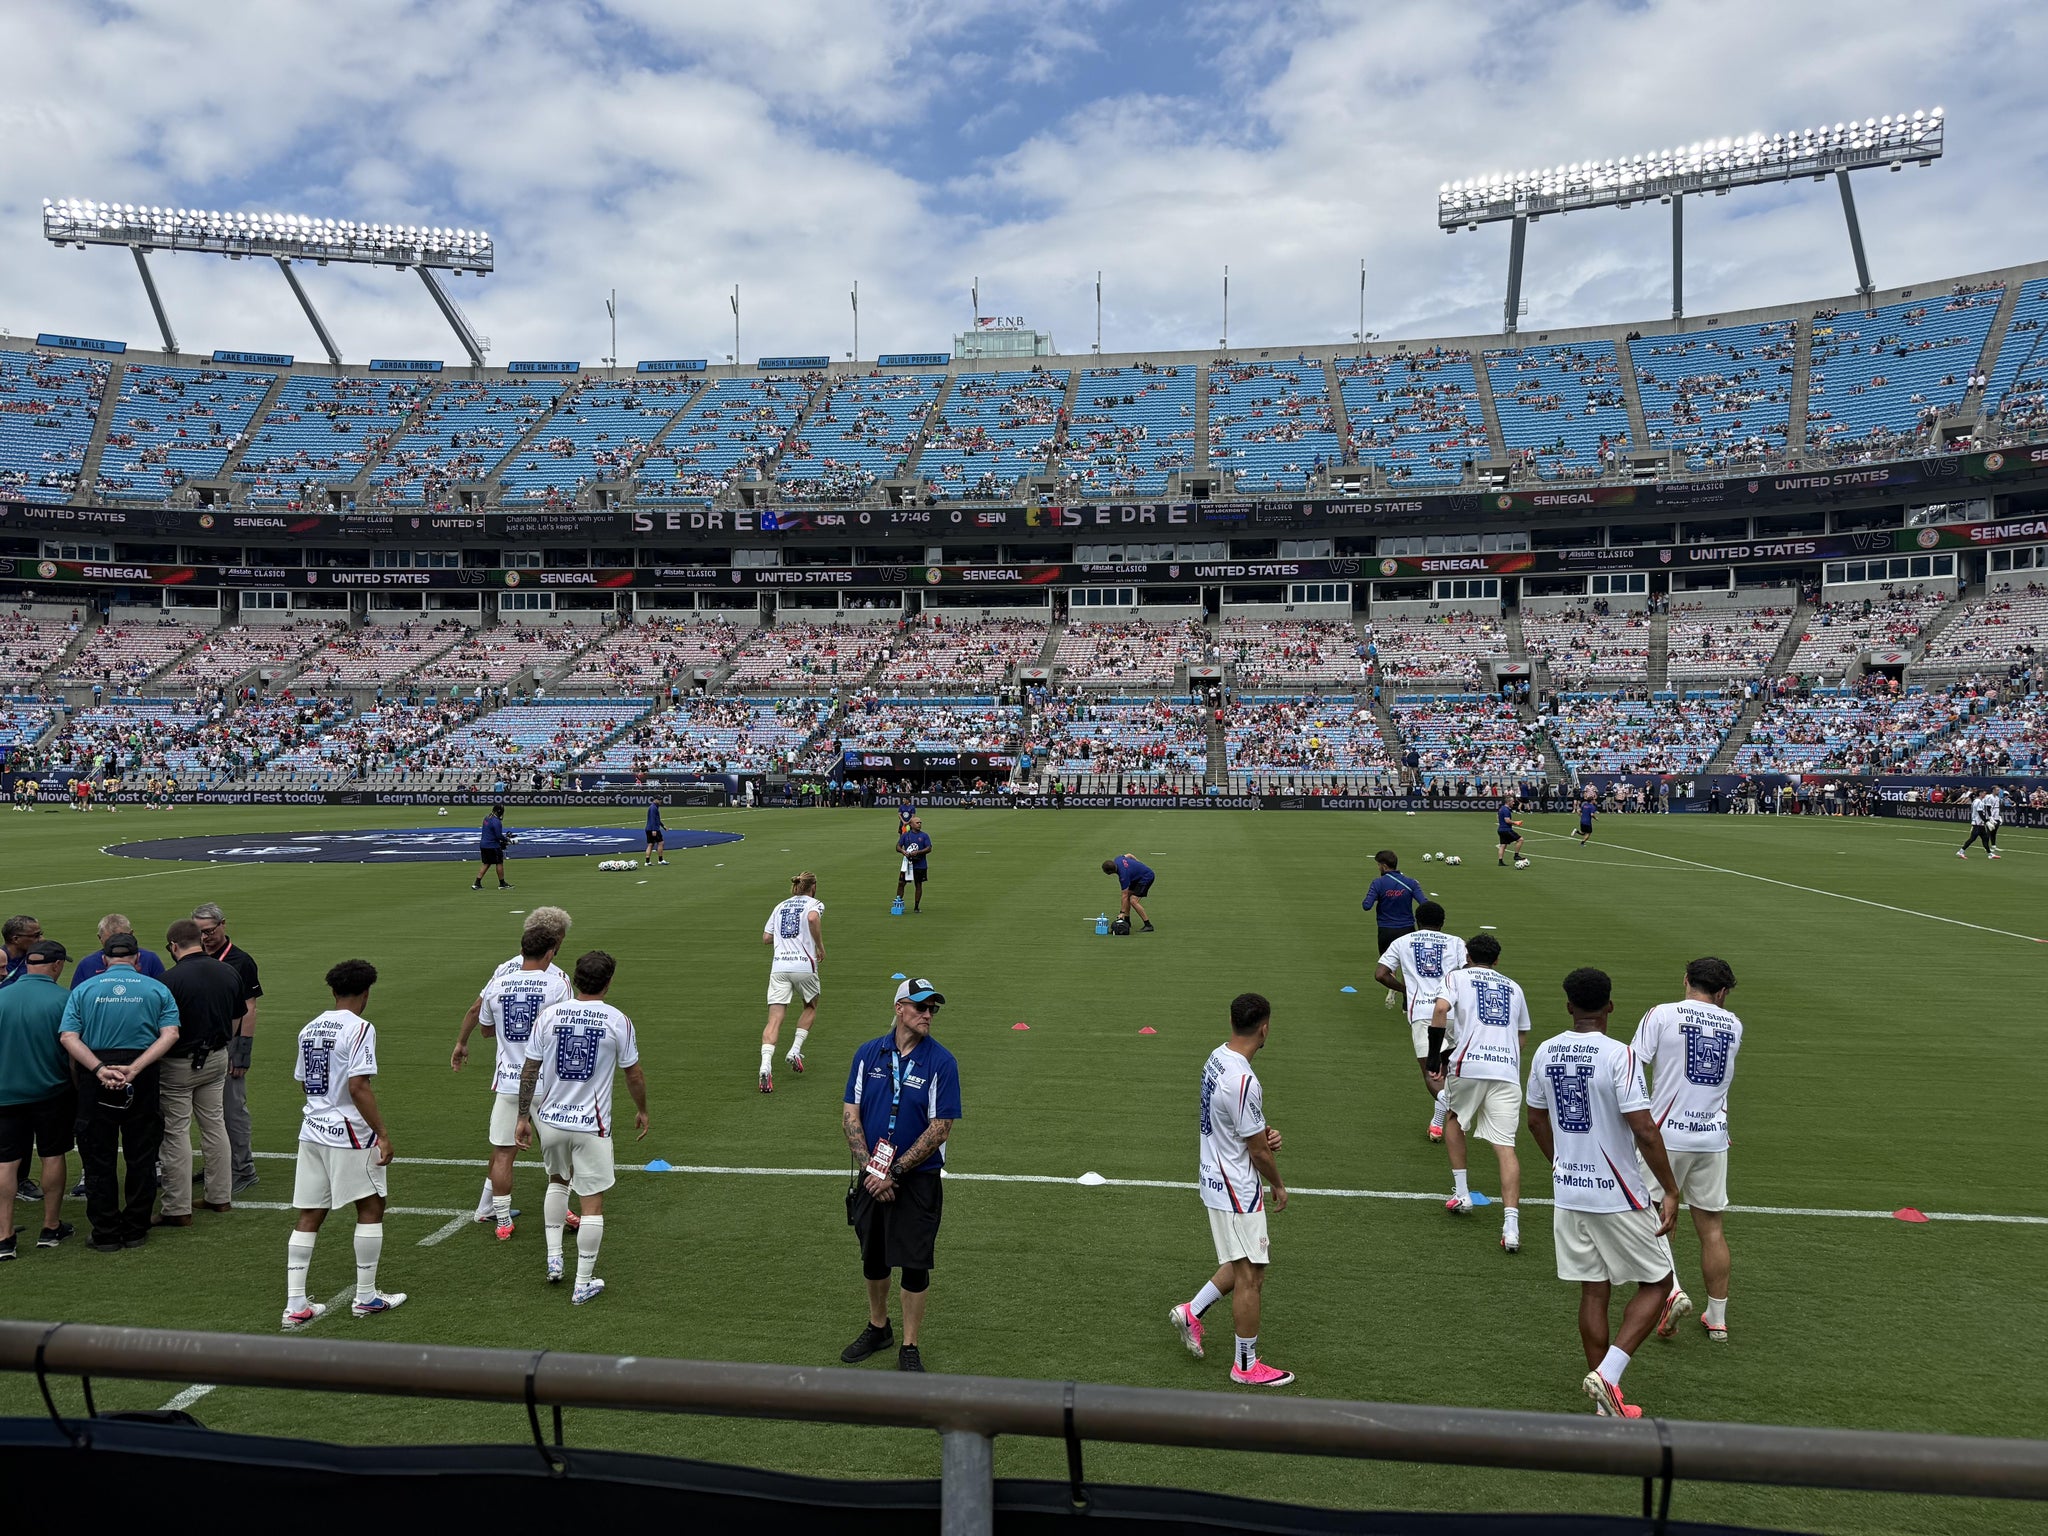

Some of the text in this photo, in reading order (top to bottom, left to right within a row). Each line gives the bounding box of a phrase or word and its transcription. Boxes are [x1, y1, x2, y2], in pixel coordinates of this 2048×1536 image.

[59, 337, 106, 350] SAM MILLS
[222, 353, 286, 364] JAKE DELHOMME
[761, 358, 826, 367] MUHSIN MUHAMMAD
[885, 355, 942, 365] JULIUS PEPPERS
[379, 360, 433, 370] JORDAN GROSS
[515, 363, 535, 371] STEVE
[537, 363, 559, 371] SMITH
[647, 361, 697, 370] WESLEY WALLS
[1775, 476, 1830, 490] UNITED
[1833, 469, 1889, 486] STATES
[1533, 493, 1594, 505] SENEGAL
[1325, 503, 1371, 514] UNITED
[1374, 502, 1423, 512] STATES
[24, 507, 76, 520] UNITED
[78, 511, 126, 522] STATES
[817, 514, 846, 526] USA
[890, 512, 931, 523] 17:46
[978, 512, 1006, 523] SEN
[233, 517, 287, 528] SENEGAL
[431, 519, 472, 528] UNITED
[506, 524, 519, 532] just
[538, 523, 554, 531] Let's
[555, 523, 573, 532] keep
[1568, 551, 1595, 559] Allstate
[1690, 546, 1750, 560] UNITED
[1753, 542, 1816, 557] STATES
[1194, 559, 1360, 577] UNITED STATES VS
[1421, 558, 1489, 572] SENEGAL
[83, 566, 152, 579] SENEGAL
[332, 570, 486, 584] UNITED STATES VS
[540, 573, 597, 584] SENEGAL
[755, 571, 852, 582] UNITED STATES
[878, 567, 908, 582] VS
[962, 569, 1022, 581] SENEGAL
[865, 756, 893, 767] USA
[197, 792, 327, 805] Forward Fest today.
[375, 793, 469, 804] Learn More at
[873, 795, 900, 806] Join
[1063, 796, 1111, 807] Soccer
[1113, 796, 1177, 807] Forward
[1179, 796, 1212, 807] Fest
[1321, 798, 1431, 809] Learn More at
[1896, 804, 1957, 819] Keep Score of
[501, 979, 548, 987] United States
[555, 1008, 609, 1020] United States
[1677, 1007, 1734, 1024] United States
[322, 1020, 344, 1031] States
[560, 1016, 603, 1027] of America
[1685, 1014, 1732, 1031] of America
[306, 1029, 337, 1038] of America
[1547, 1044, 1599, 1054] United States
[1466, 1052, 1508, 1064] Pre-Match
[1551, 1053, 1592, 1064] of America
[1211, 1057, 1226, 1075] States
[581, 1115, 595, 1125] Top
[1667, 1118, 1716, 1132] Pre-Match
[328, 1125, 345, 1137] Top
[1208, 1178, 1224, 1192] Top
[1595, 1177, 1615, 1191] Top
